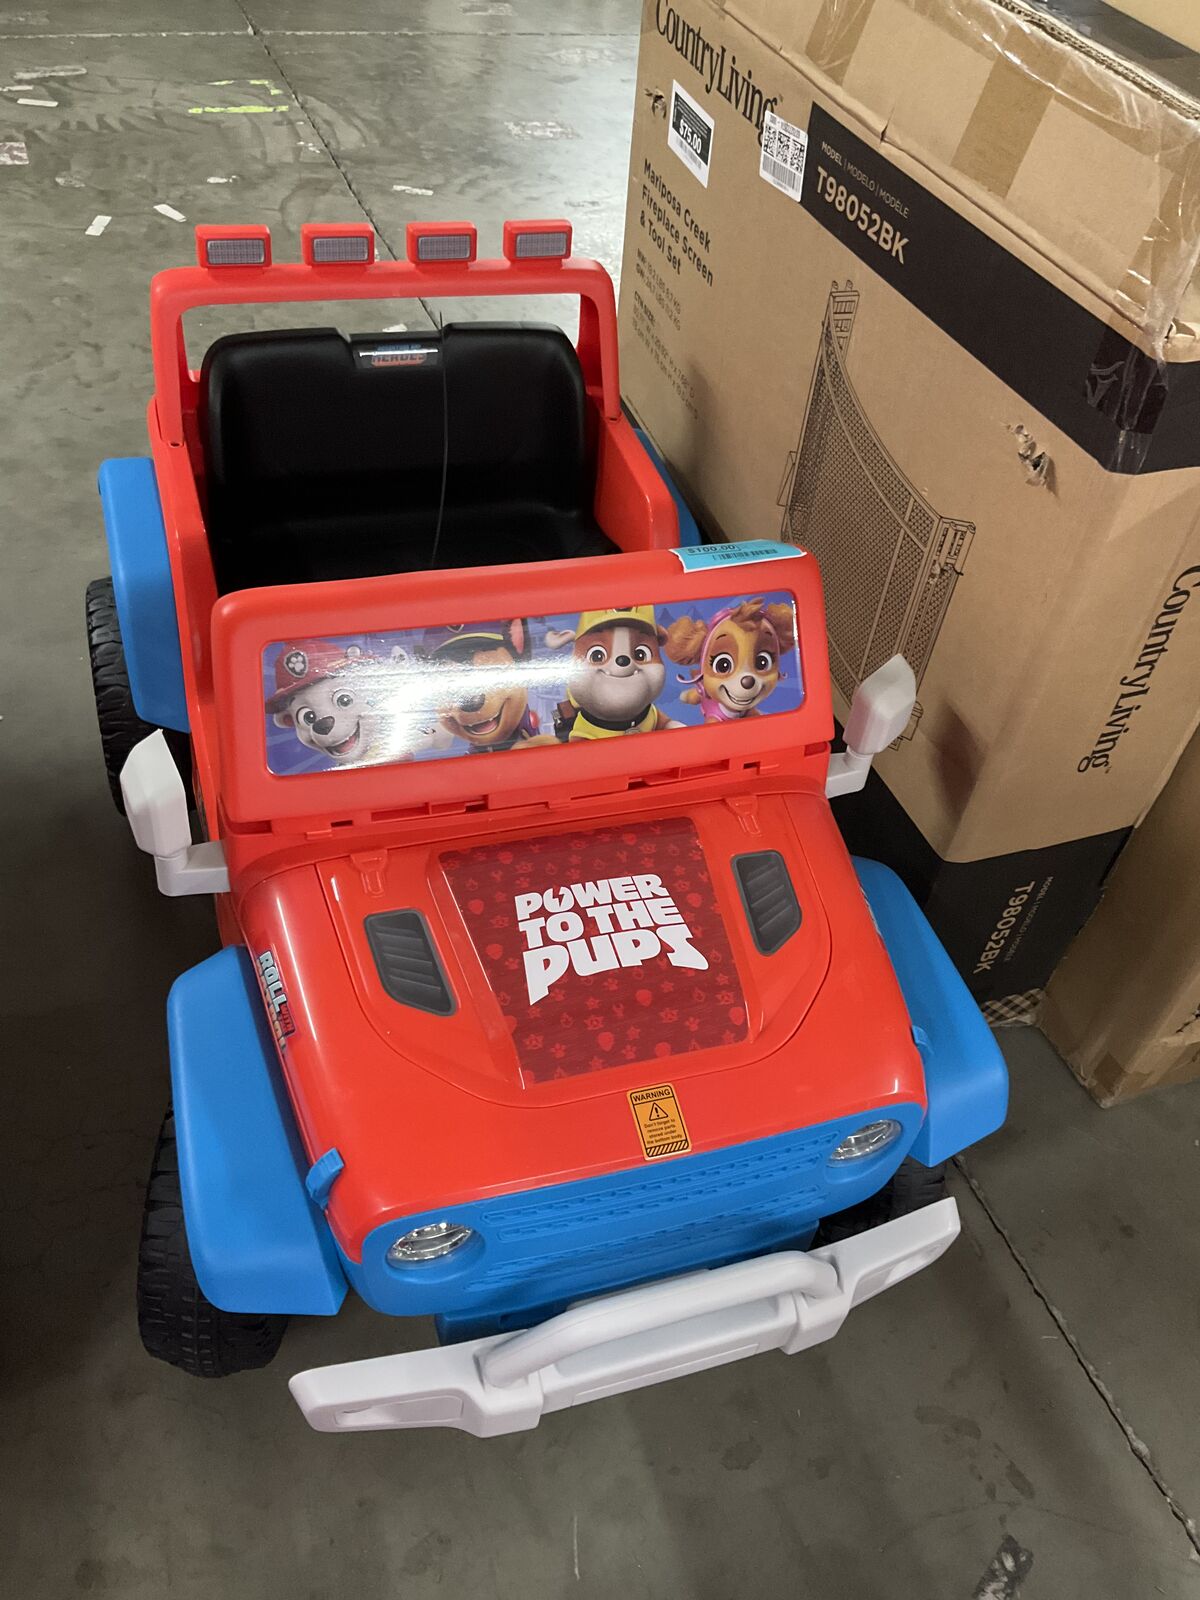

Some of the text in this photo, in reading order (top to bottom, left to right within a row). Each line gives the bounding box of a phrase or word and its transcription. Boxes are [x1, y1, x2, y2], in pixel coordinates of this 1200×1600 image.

[679, 118, 703, 155] $75.00
[821, 141, 843, 167] MODEL
[847, 162, 876, 193] MODELO
[641, 184, 714, 288] Fireplace Screen
[643, 157, 681, 218] Mariposa
[683, 207, 711, 254] Creek
[817, 165, 910, 265] T98052BK
[640, 209, 682, 276] & Tool Set
[686, 543, 736, 554] $100.00
[514, 873, 670, 921] POWER
[518, 896, 685, 949] TO THE
[972, 880, 1036, 975] T98052BK
[259, 950, 287, 1014] ROLL
[522, 923, 710, 1007] PUPS
[632, 1088, 671, 1102] WARNING
